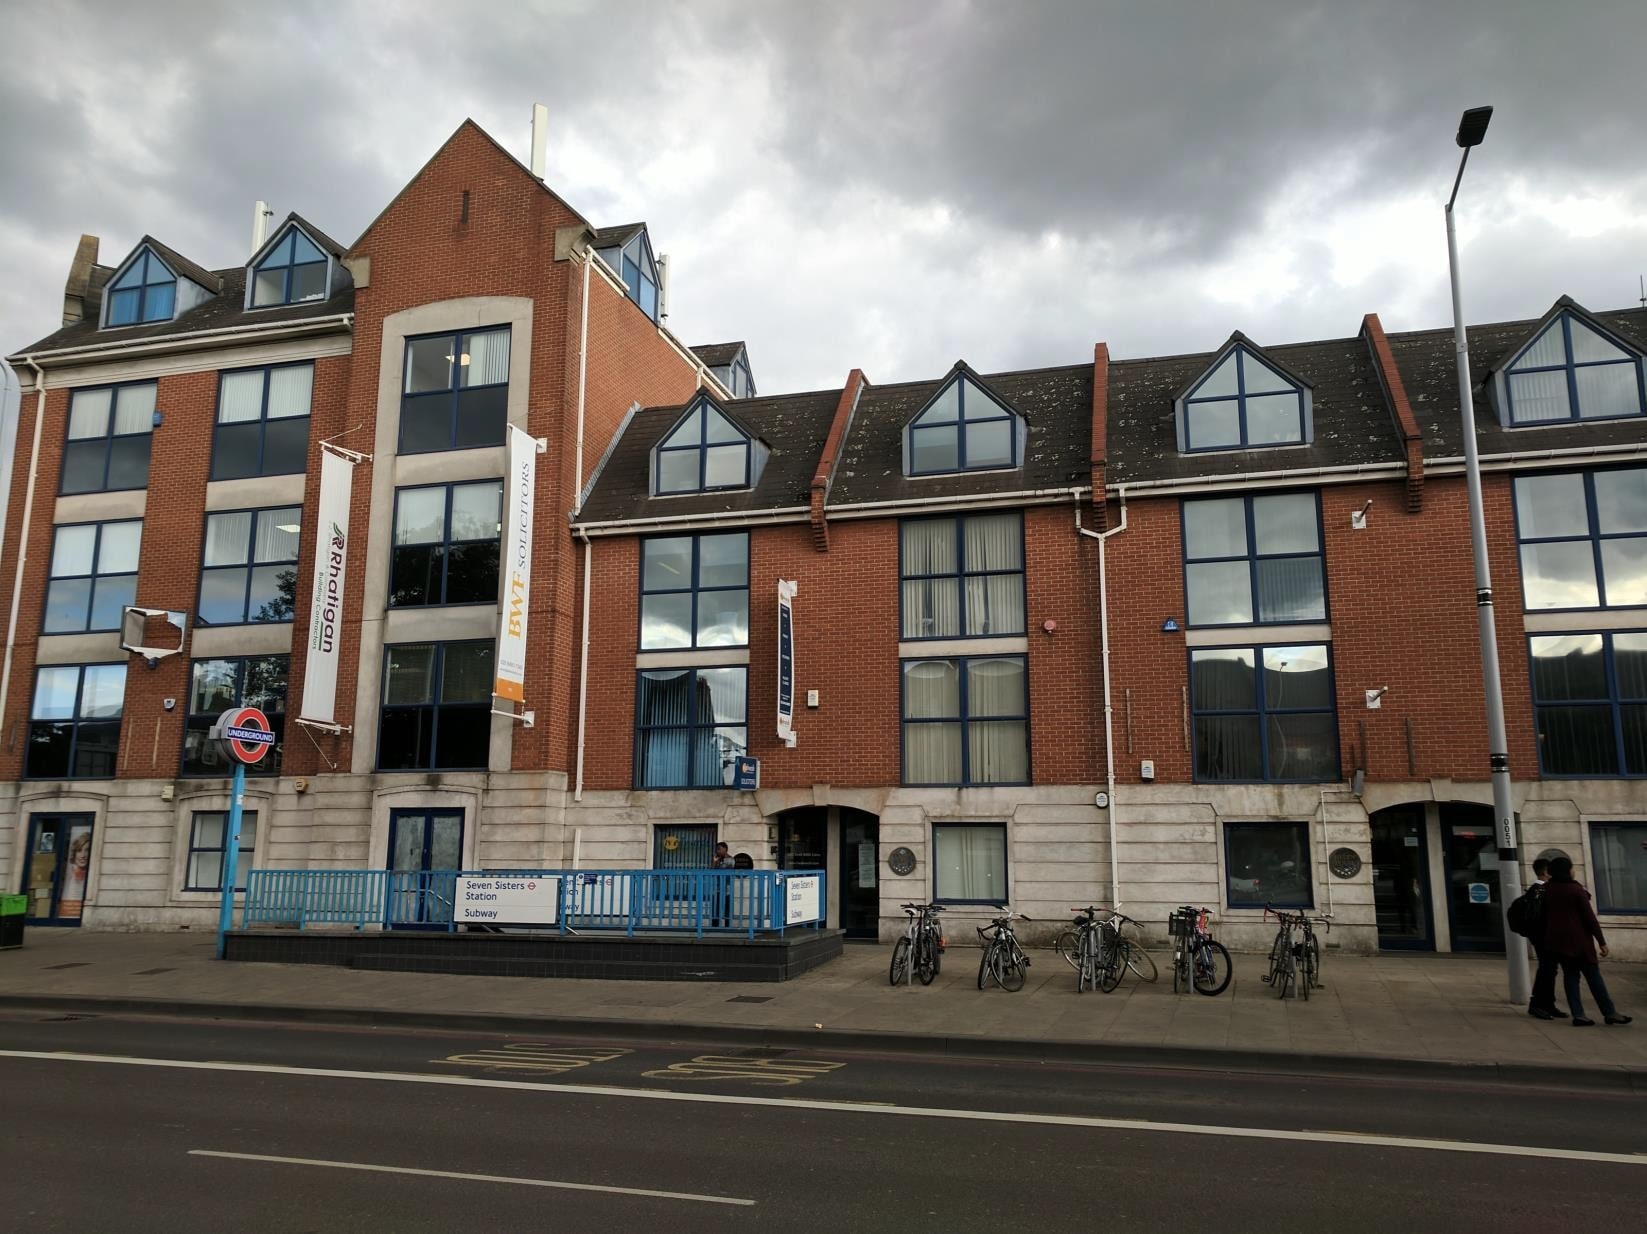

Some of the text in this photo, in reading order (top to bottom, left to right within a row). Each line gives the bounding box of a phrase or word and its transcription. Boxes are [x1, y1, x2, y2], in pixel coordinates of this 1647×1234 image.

[518, 462, 529, 568] SOLICITORS
[312, 571, 325, 650] Building Contractors
[322, 553, 342, 653] Rhatigan
[508, 570, 527, 640] BWF
[228, 729, 273, 741] UNDERGROUND
[465, 892, 497, 901] Station
[466, 881, 525, 890] Seven Sisters
[465, 908, 498, 919] Subway
